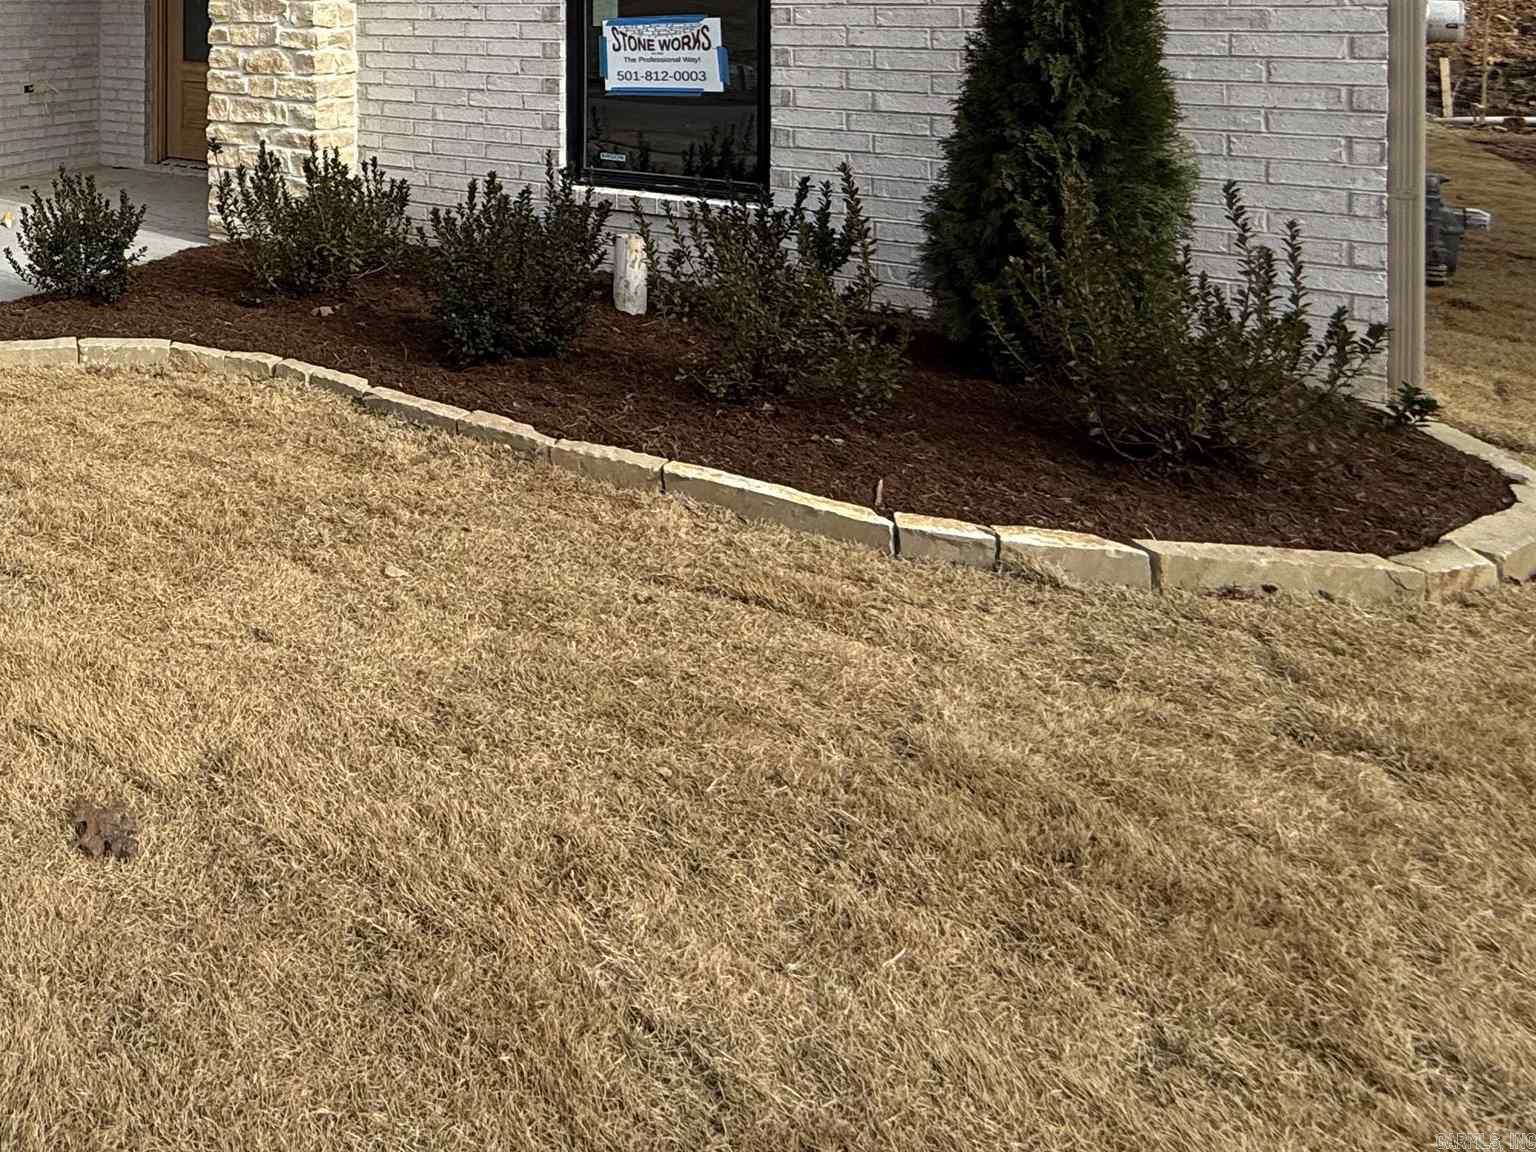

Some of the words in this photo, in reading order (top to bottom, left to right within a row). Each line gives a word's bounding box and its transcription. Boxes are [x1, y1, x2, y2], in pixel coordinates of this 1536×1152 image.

[611, 26, 655, 52] STONE
[659, 24, 712, 51] WORKS
[617, 70, 706, 82] 501-812-0003
